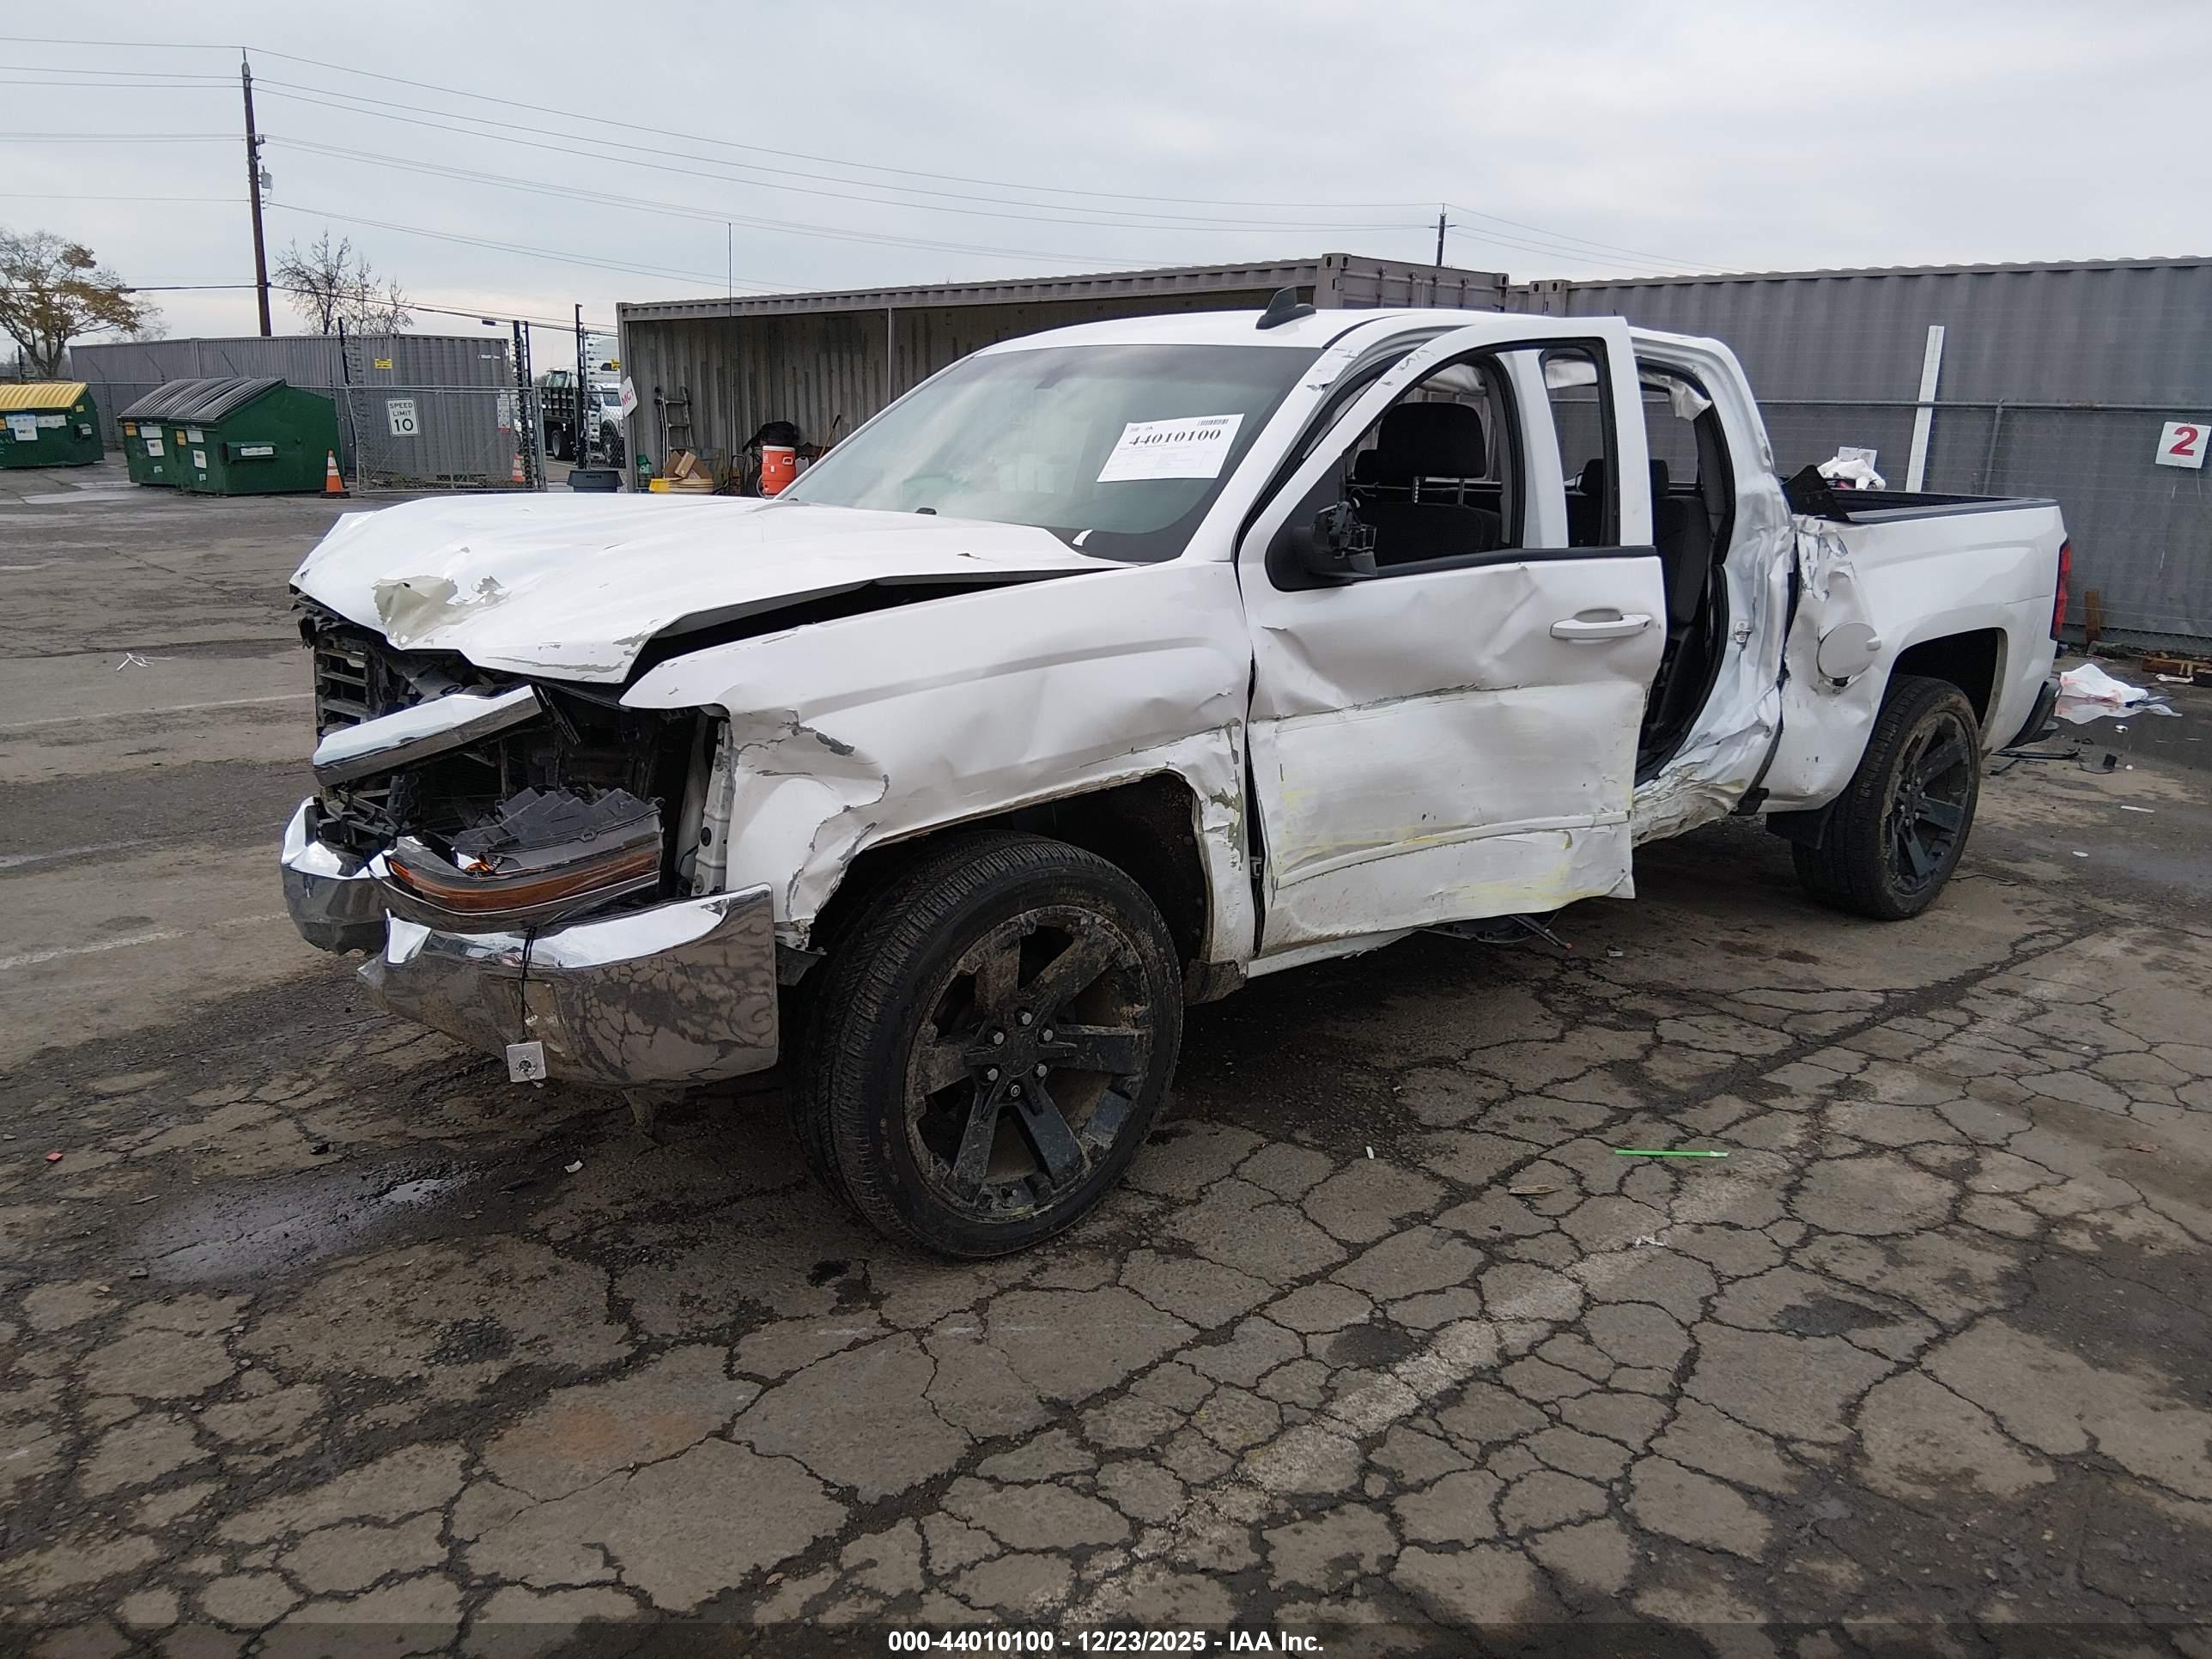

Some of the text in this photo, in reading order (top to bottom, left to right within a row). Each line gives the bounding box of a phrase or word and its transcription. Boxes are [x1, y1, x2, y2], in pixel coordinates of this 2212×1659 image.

[394, 418, 414, 432] 10
[1128, 428, 1222, 446] 44010100
[2168, 426, 2198, 456] 2
